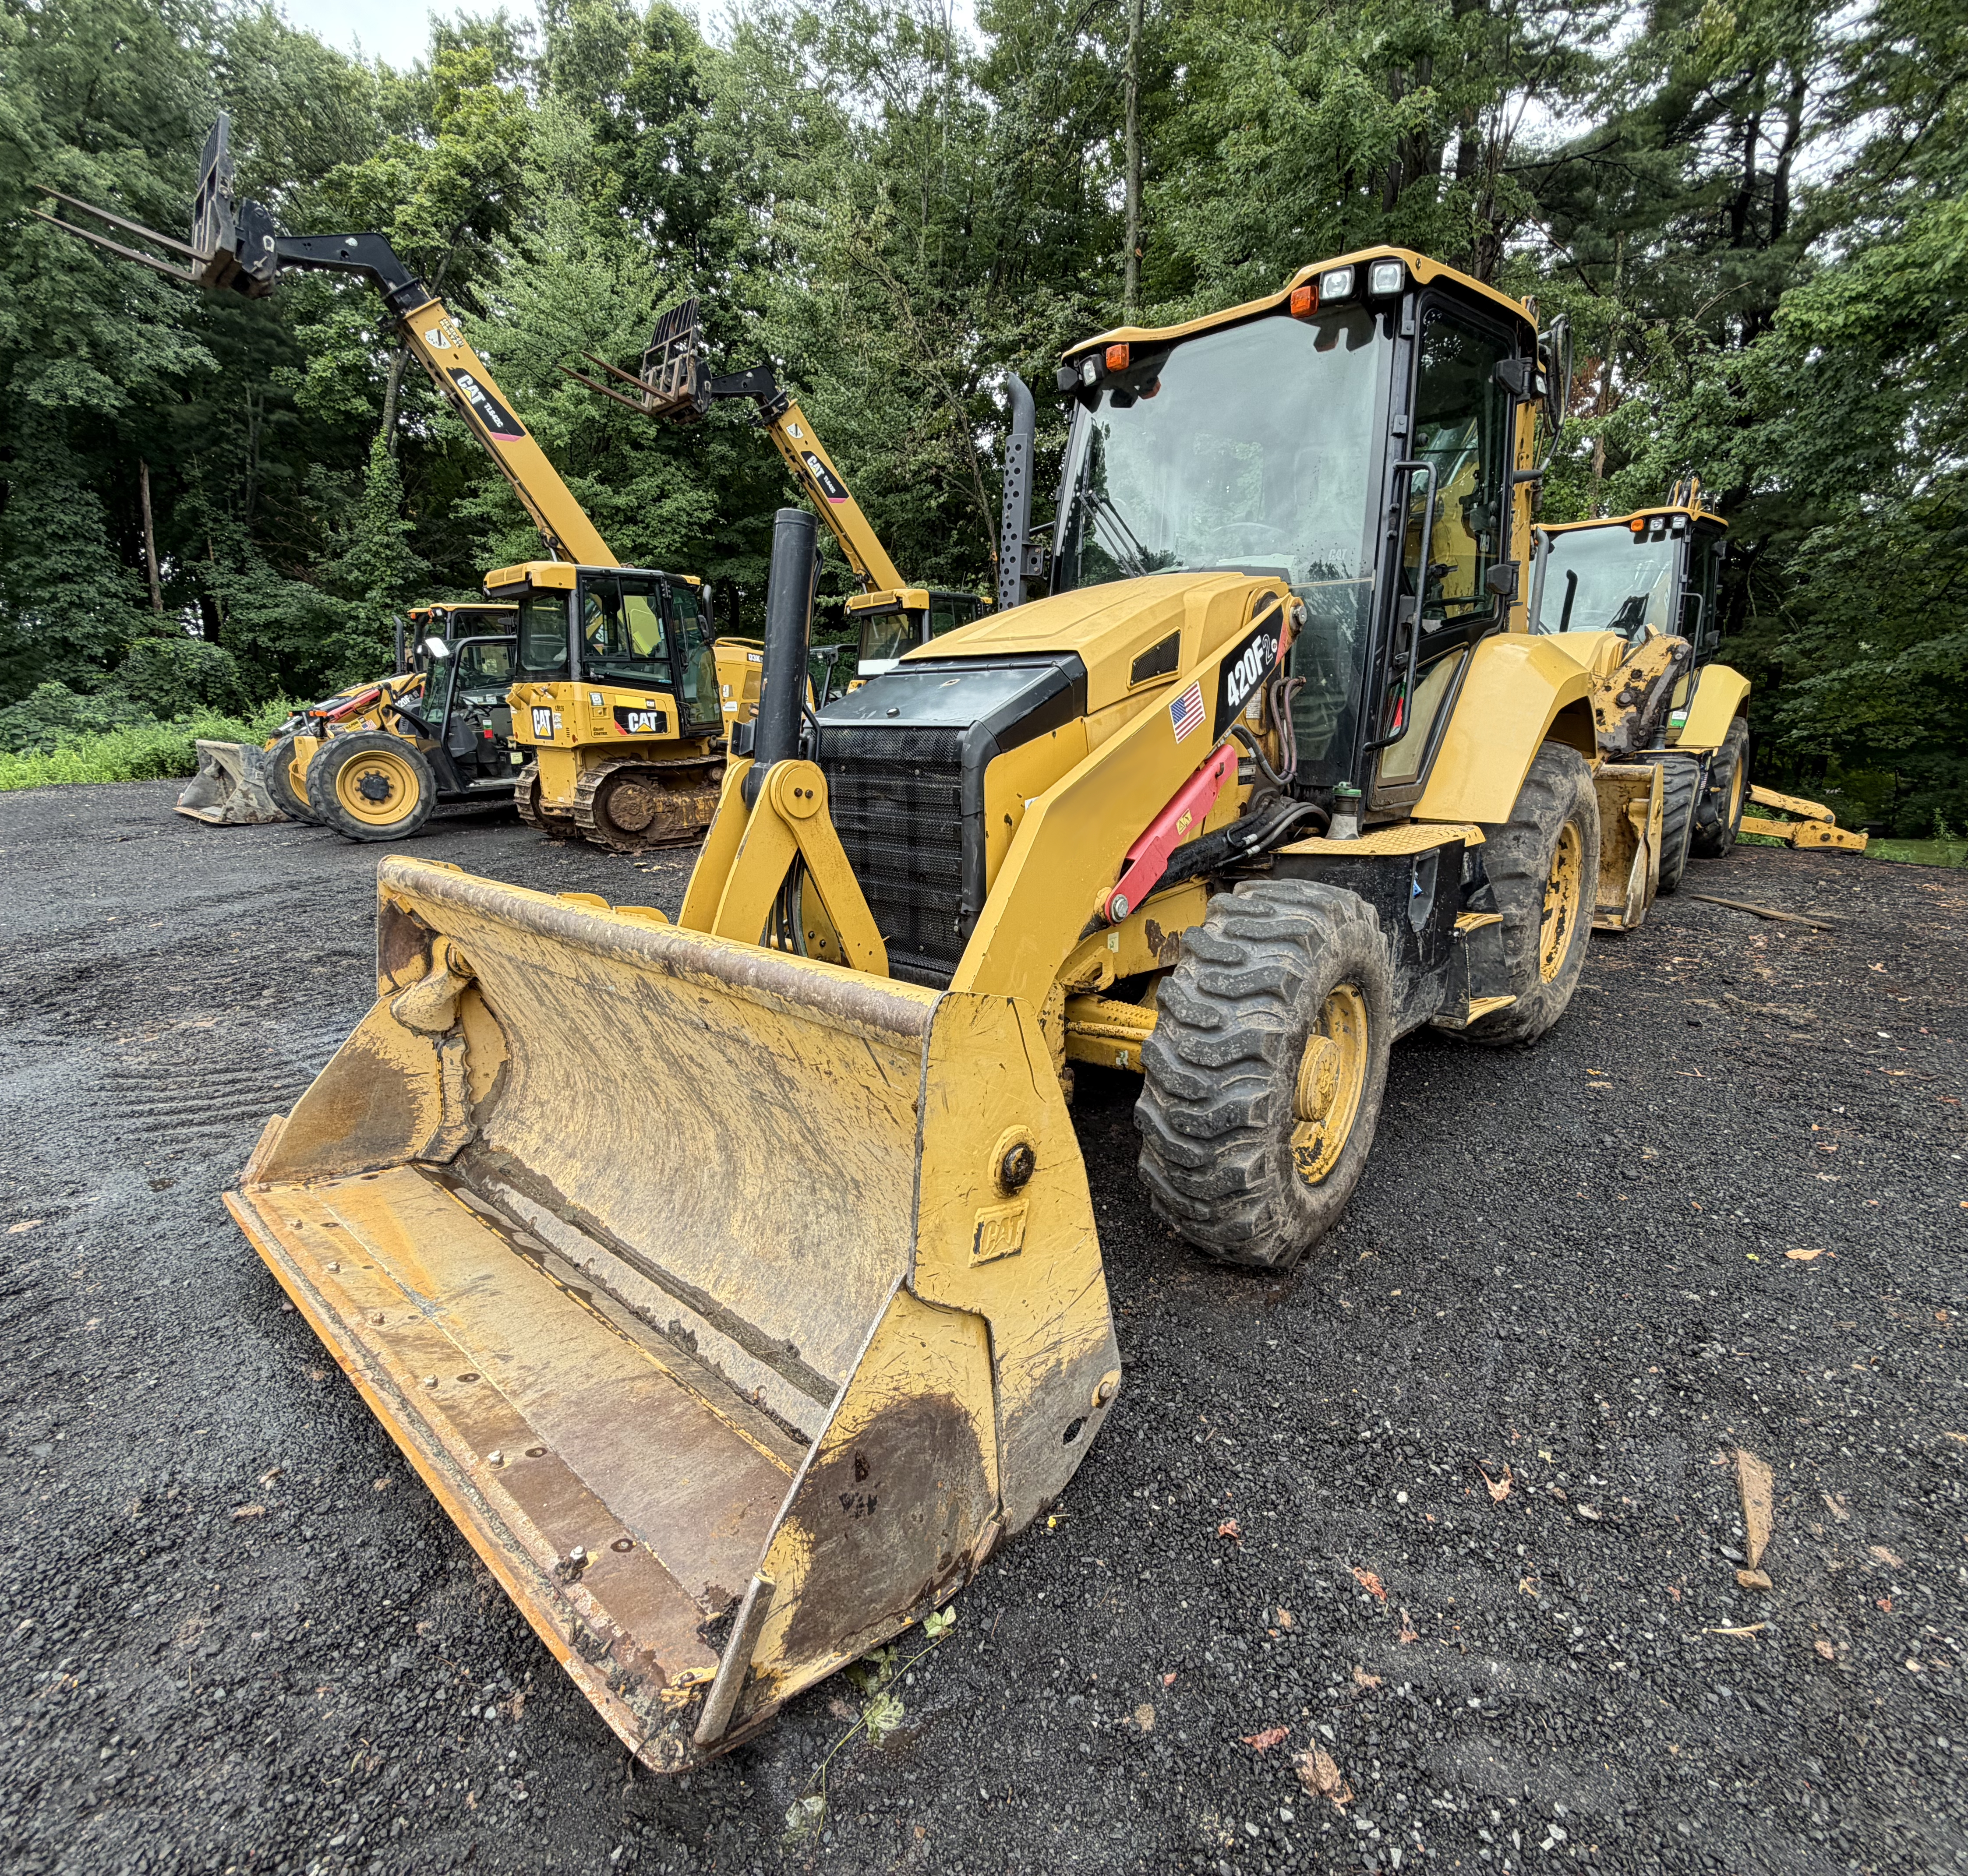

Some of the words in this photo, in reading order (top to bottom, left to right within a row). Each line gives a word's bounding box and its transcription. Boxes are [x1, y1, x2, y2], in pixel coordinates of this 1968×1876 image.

[457, 375, 486, 404] CAT
[807, 455, 825, 478] CAT
[1328, 549, 1347, 561] CAT
[1228, 634, 1273, 706] 420F2
[533, 709, 551, 736] CAT
[628, 712, 657, 732] CAT
[981, 1212, 1023, 1256] CAT
